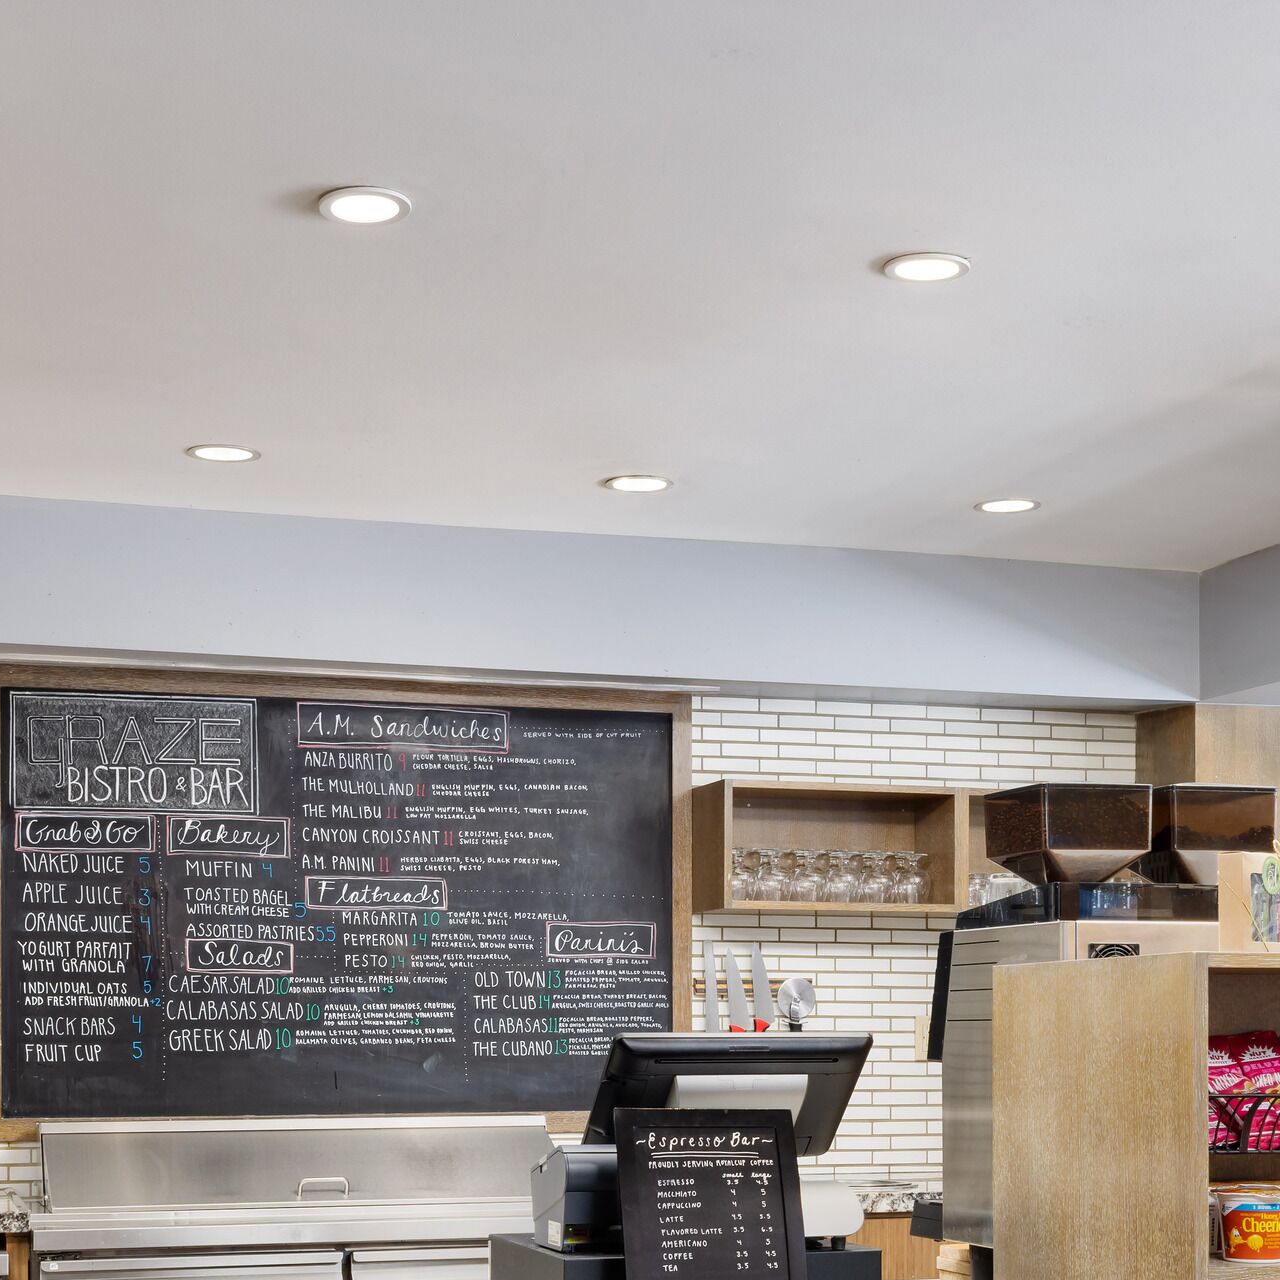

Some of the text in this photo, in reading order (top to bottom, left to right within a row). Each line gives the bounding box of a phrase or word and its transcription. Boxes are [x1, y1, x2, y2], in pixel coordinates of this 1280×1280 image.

[307, 712, 501, 741] A.M. Sandwiches
[27, 715, 241, 789] GRAZE
[304, 751, 406, 771] ANZA BURRITO 9
[67, 766, 248, 807] BISTRO & BAR
[301, 777, 425, 797] THE MULHOLLAND 11
[302, 804, 398, 819] THE MALIBU 11
[25, 819, 82, 844] Grab
[106, 820, 145, 844] Go
[177, 819, 280, 856] Bakery
[302, 827, 453, 846] CANYON CROISSANT 11
[22, 852, 152, 874] NAKED JUICE 5
[186, 860, 273, 878] MUFFIN 4
[302, 854, 390, 873] A.M. PANINI 11
[22, 882, 151, 906] APPLE JUICE 3
[184, 887, 293, 907] TOASTED BAGEL
[317, 880, 440, 905] Flatbreads
[186, 902, 307, 918] WITH CREAM CHEESE 5
[342, 911, 440, 927] MARGARITA 10
[24, 912, 151, 935] ORANGE JUICE 4
[185, 923, 253, 939] ASSORTED
[258, 925, 315, 942] PASTRIES
[343, 933, 427, 947] PEPPERONI 14
[17, 940, 132, 960] YOGURT PARFAIT
[198, 941, 284, 967] Salads
[22, 955, 152, 973] WITH GRANOLA 7
[345, 954, 405, 969] PESTO 14
[23, 980, 152, 994] INDIVIDUAL OATS 5
[169, 975, 290, 995] CAESAR SALAD 10
[474, 970, 561, 989] OLD TOWN 13
[24, 996, 44, 1006] ADD
[47, 996, 76, 1007] FRESH
[150, 998, 161, 1007] +2
[166, 1000, 320, 1021] CALABASAS SALAD 10
[473, 994, 550, 1010] THE CLUB 14
[23, 1015, 142, 1036] SNACK BARS 4
[474, 1017, 559, 1034] CALABASAS 11
[169, 1028, 291, 1052] GREEK SALAD 10
[473, 1039, 568, 1057] THE CUBANO 13
[25, 1041, 143, 1062] FRUIT CUP 5
[648, 1132, 760, 1150] Espresso Bar
[648, 1160, 679, 1169] PROUDLY
[682, 1160, 713, 1168] SERVING
[657, 1190, 697, 1198] MACCHIATO
[657, 1202, 702, 1210] CAPPUCCINO
[660, 1216, 684, 1224] LATTE
[661, 1227, 723, 1236] FLAVORED LATTE
[661, 1240, 708, 1249] AMERICANO
[662, 1264, 678, 1272] TEA
